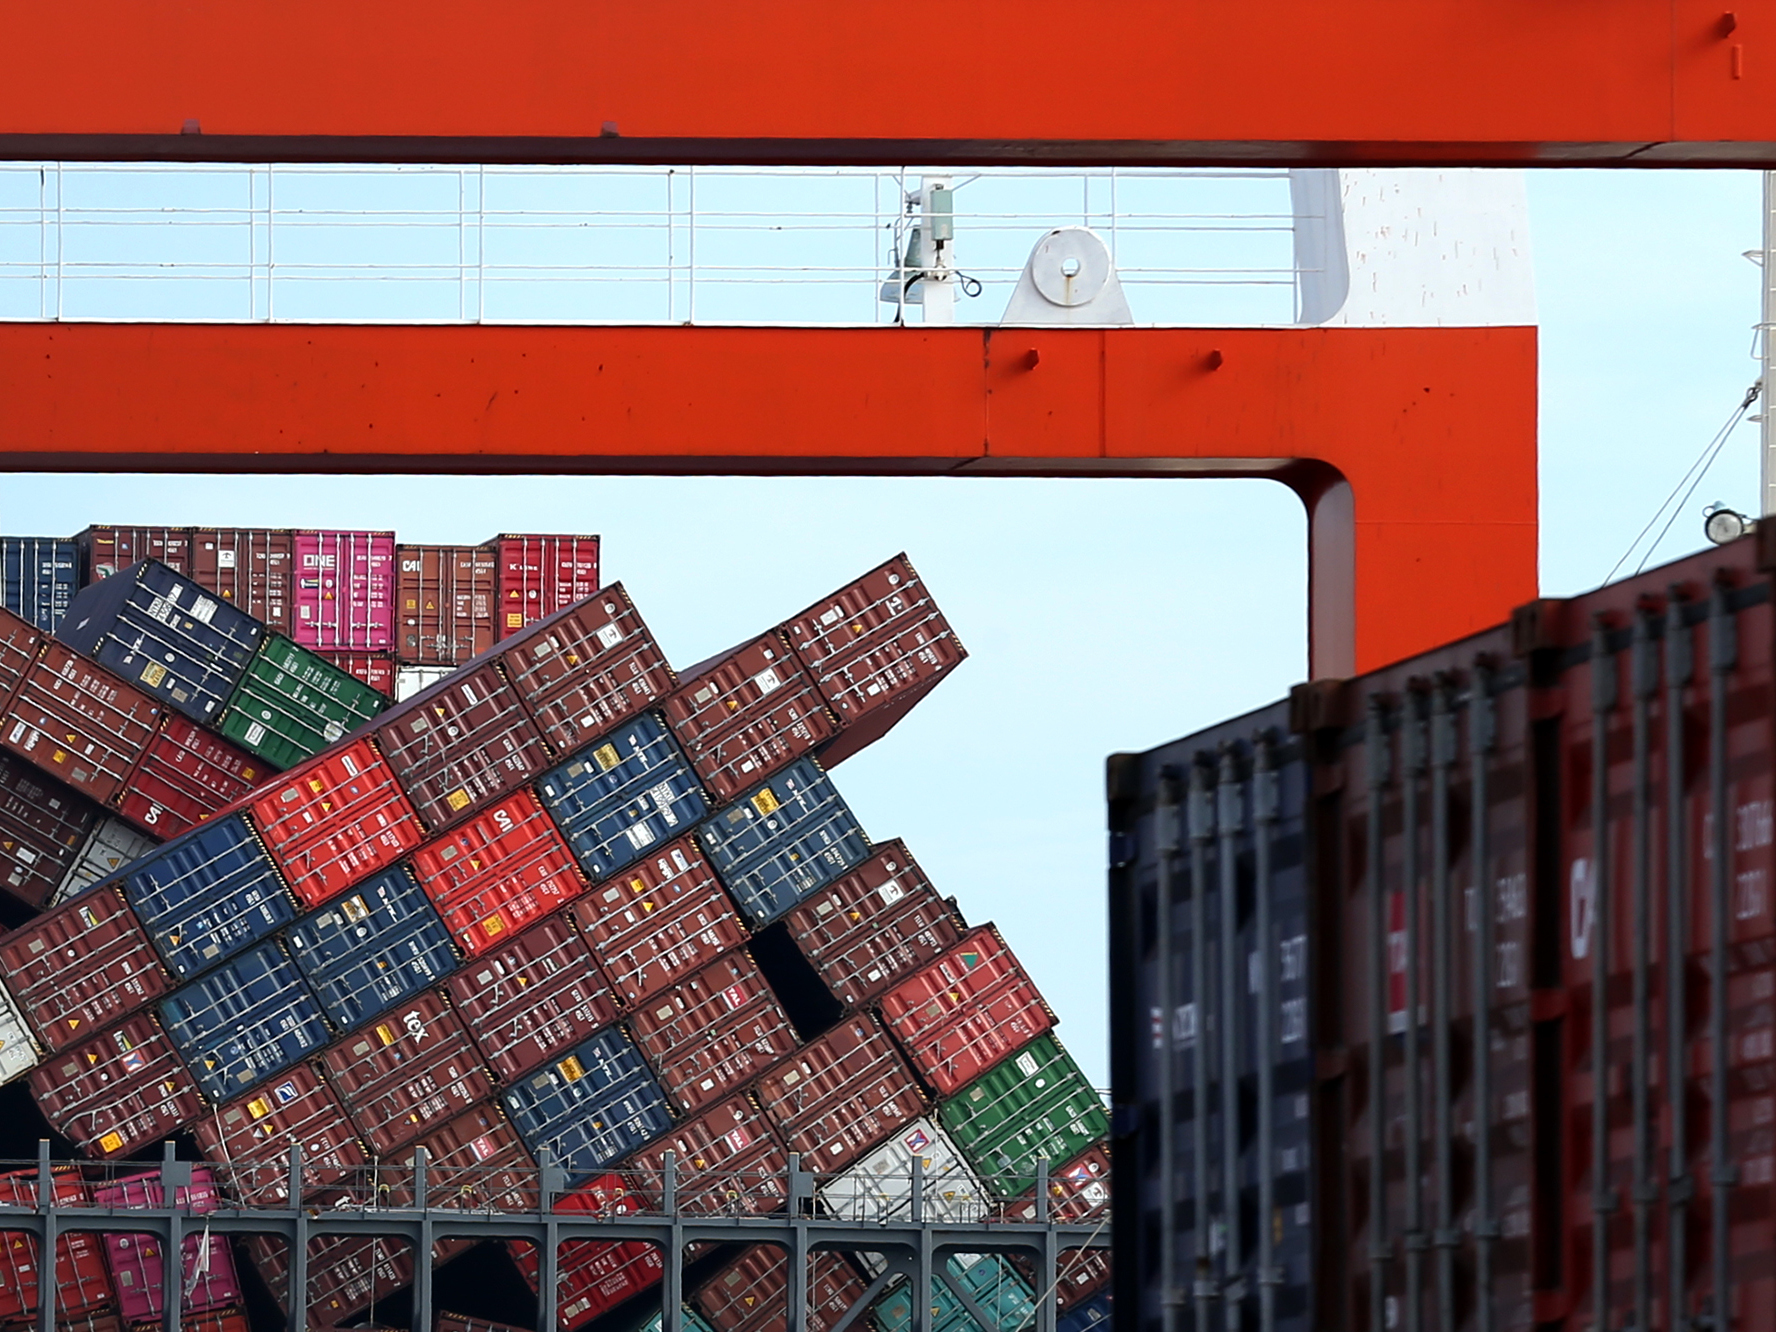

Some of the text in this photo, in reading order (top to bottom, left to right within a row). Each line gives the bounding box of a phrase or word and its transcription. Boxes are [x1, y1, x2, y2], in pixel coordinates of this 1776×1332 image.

[303, 555, 334, 567] ONE
[147, 596, 164, 616] NYKU
[657, 781, 675, 803] NYKU
[143, 802, 164, 825] CAI
[491, 808, 513, 833] CAI
[726, 986, 743, 1006] TAL
[401, 1008, 432, 1044] tex
[475, 1137, 491, 1157] TAL
[729, 1130, 745, 1149] TAL
